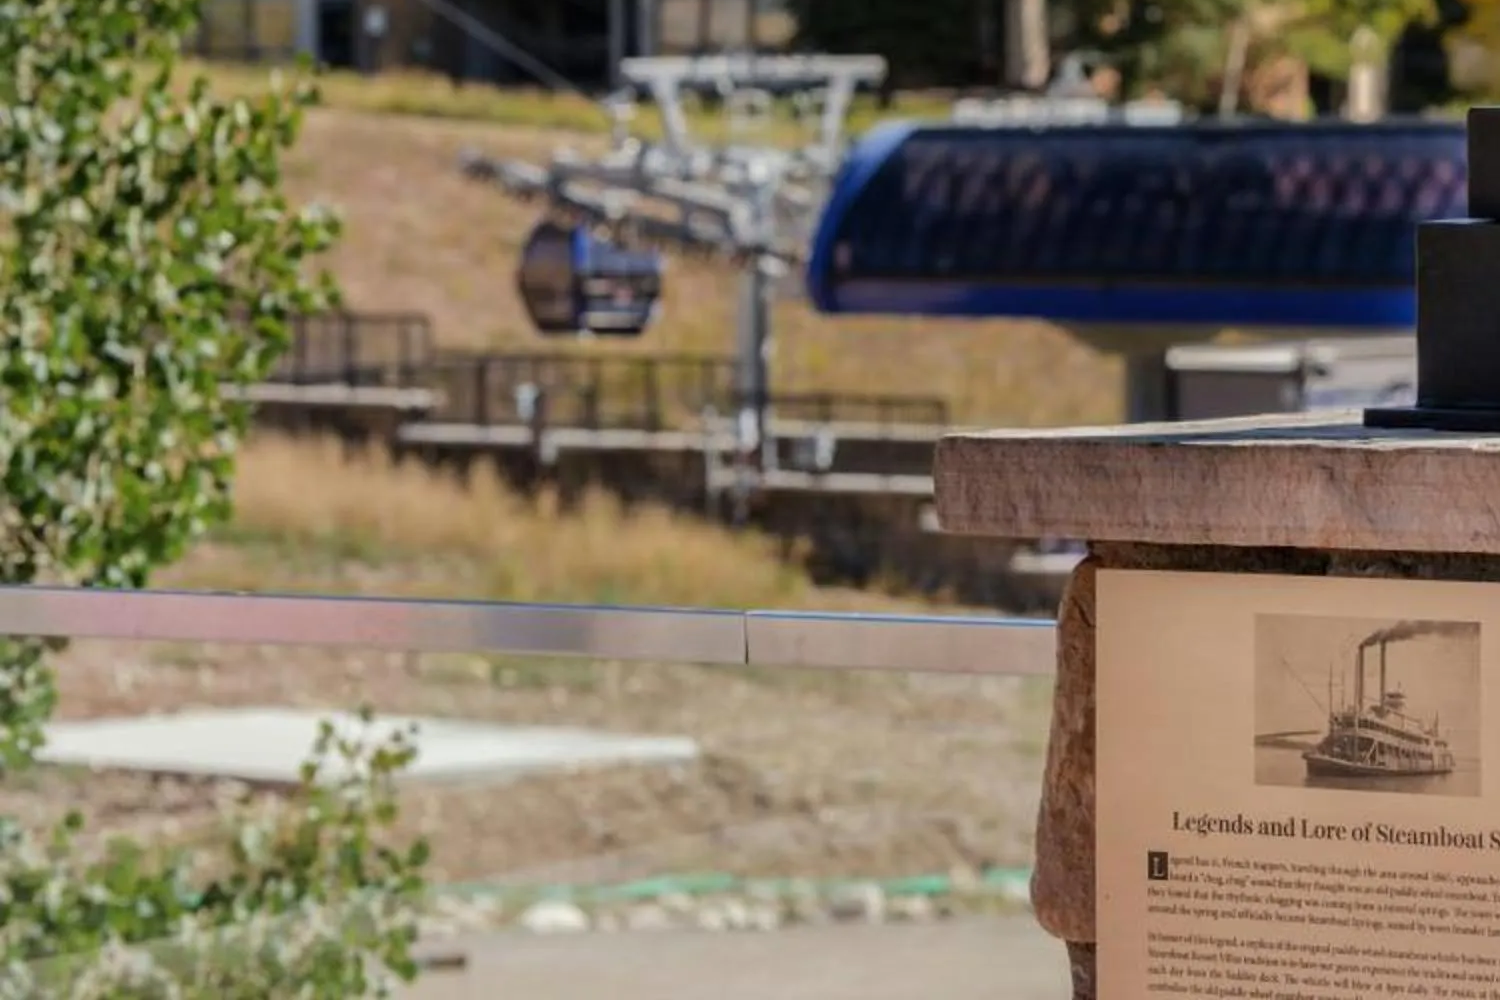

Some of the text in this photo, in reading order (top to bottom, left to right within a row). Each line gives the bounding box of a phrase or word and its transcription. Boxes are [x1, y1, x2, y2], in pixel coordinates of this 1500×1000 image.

[1172, 811, 1253, 836] Legends
[1258, 817, 1295, 837] and
[1301, 819, 1347, 840] Lore
[1351, 822, 1373, 842] of
[1375, 823, 1483, 849] Steamboat
